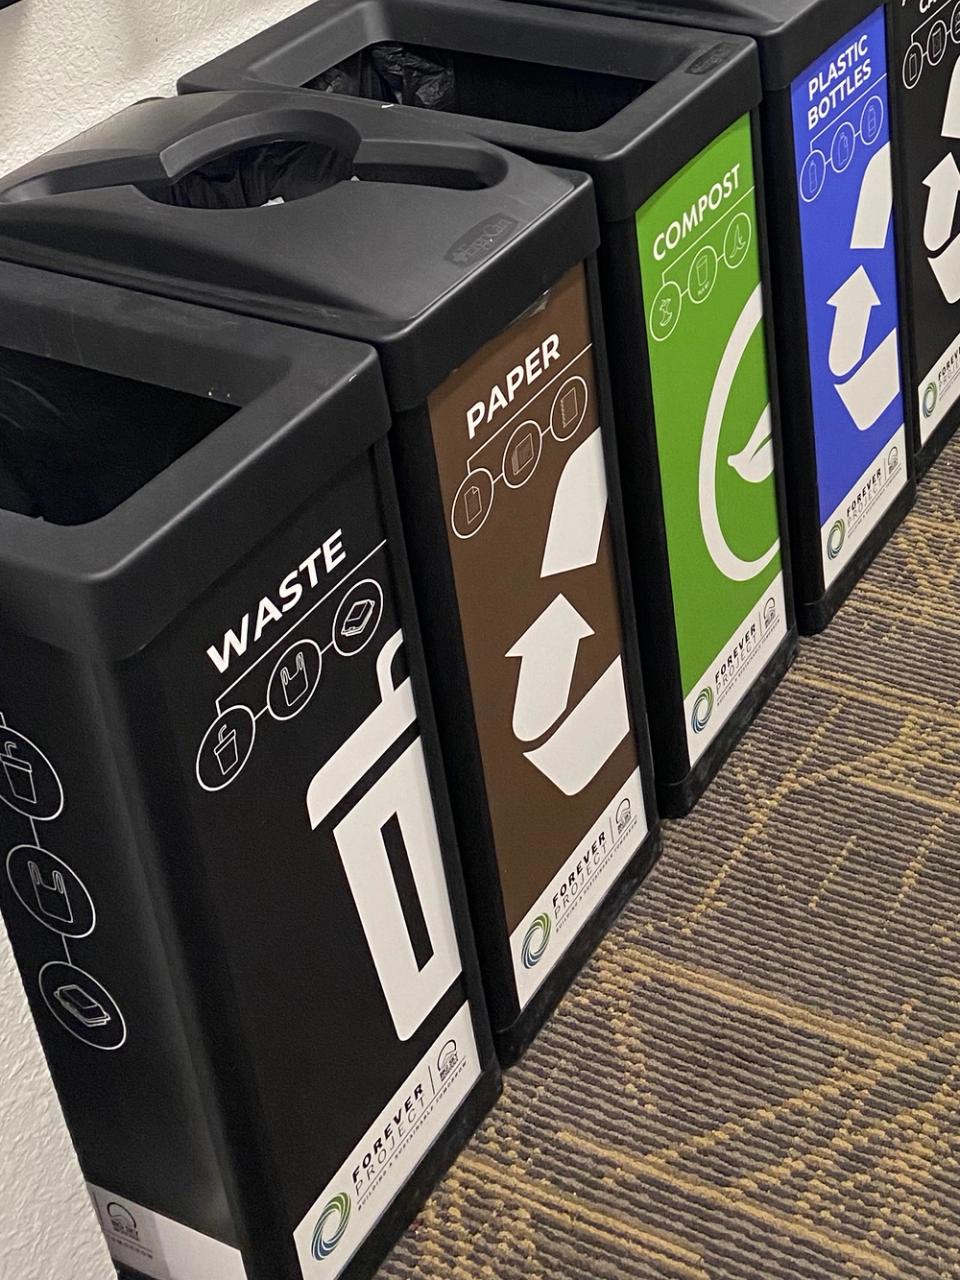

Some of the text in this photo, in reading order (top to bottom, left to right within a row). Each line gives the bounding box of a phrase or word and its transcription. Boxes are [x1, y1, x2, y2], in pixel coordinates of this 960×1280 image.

[806, 59, 873, 132] BOTTLES
[807, 34, 869, 102] PLASTIC
[651, 163, 742, 262] COMPOST
[464, 332, 563, 439] PAPER
[846, 468, 882, 518] FOREVER
[847, 478, 883, 527] PROJECT
[205, 529, 348, 674] WASTE
[714, 623, 756, 684] FOREVER
[716, 634, 758, 695] PROJECT
[552, 832, 606, 908] FOREVER
[554, 844, 608, 920] PROJECT
[352, 1083, 425, 1184] FOREVER
[355, 1099, 426, 1197] PROJECT
[358, 1170, 387, 1212] BUILDING
[393, 1106, 435, 1160] SUSTAINABLE
